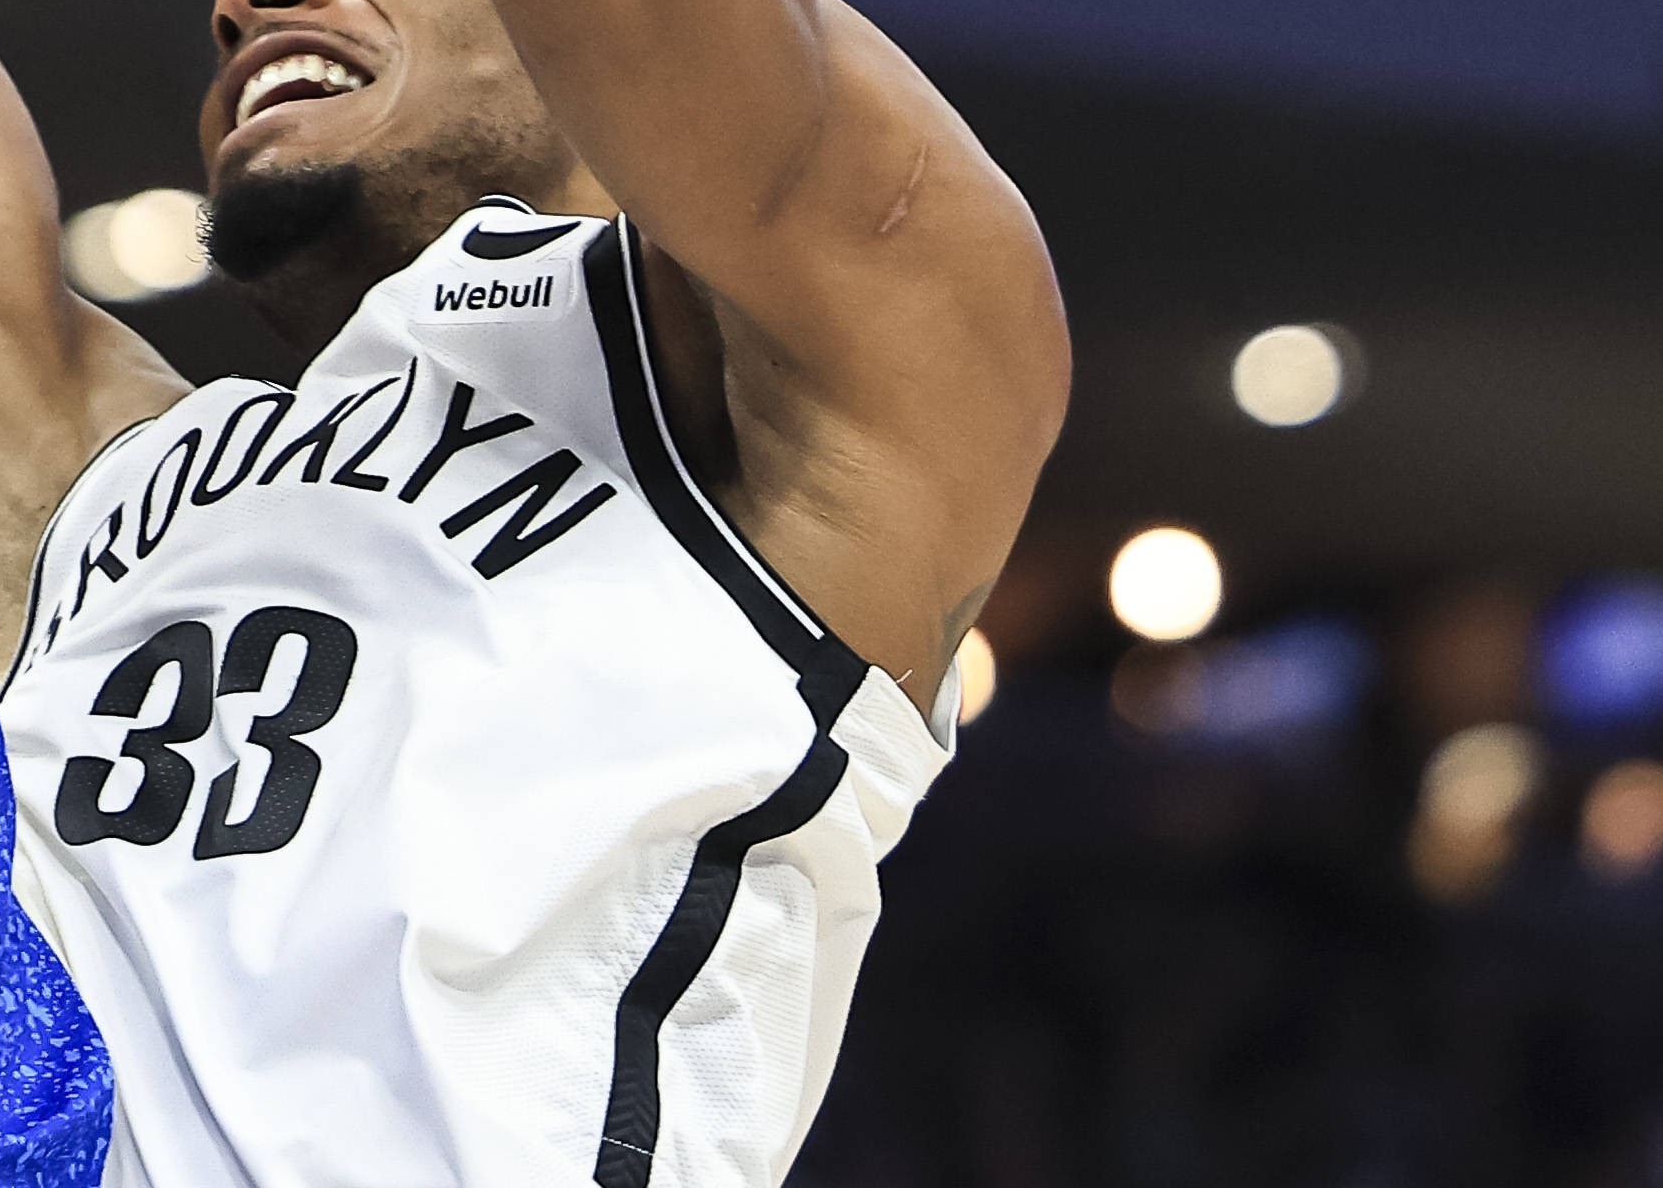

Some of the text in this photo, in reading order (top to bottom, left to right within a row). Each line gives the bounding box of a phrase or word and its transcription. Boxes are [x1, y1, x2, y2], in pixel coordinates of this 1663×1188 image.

[434, 275, 554, 311] Webull
[25, 356, 617, 674] ROOKLYN
[54, 605, 358, 861] 33
